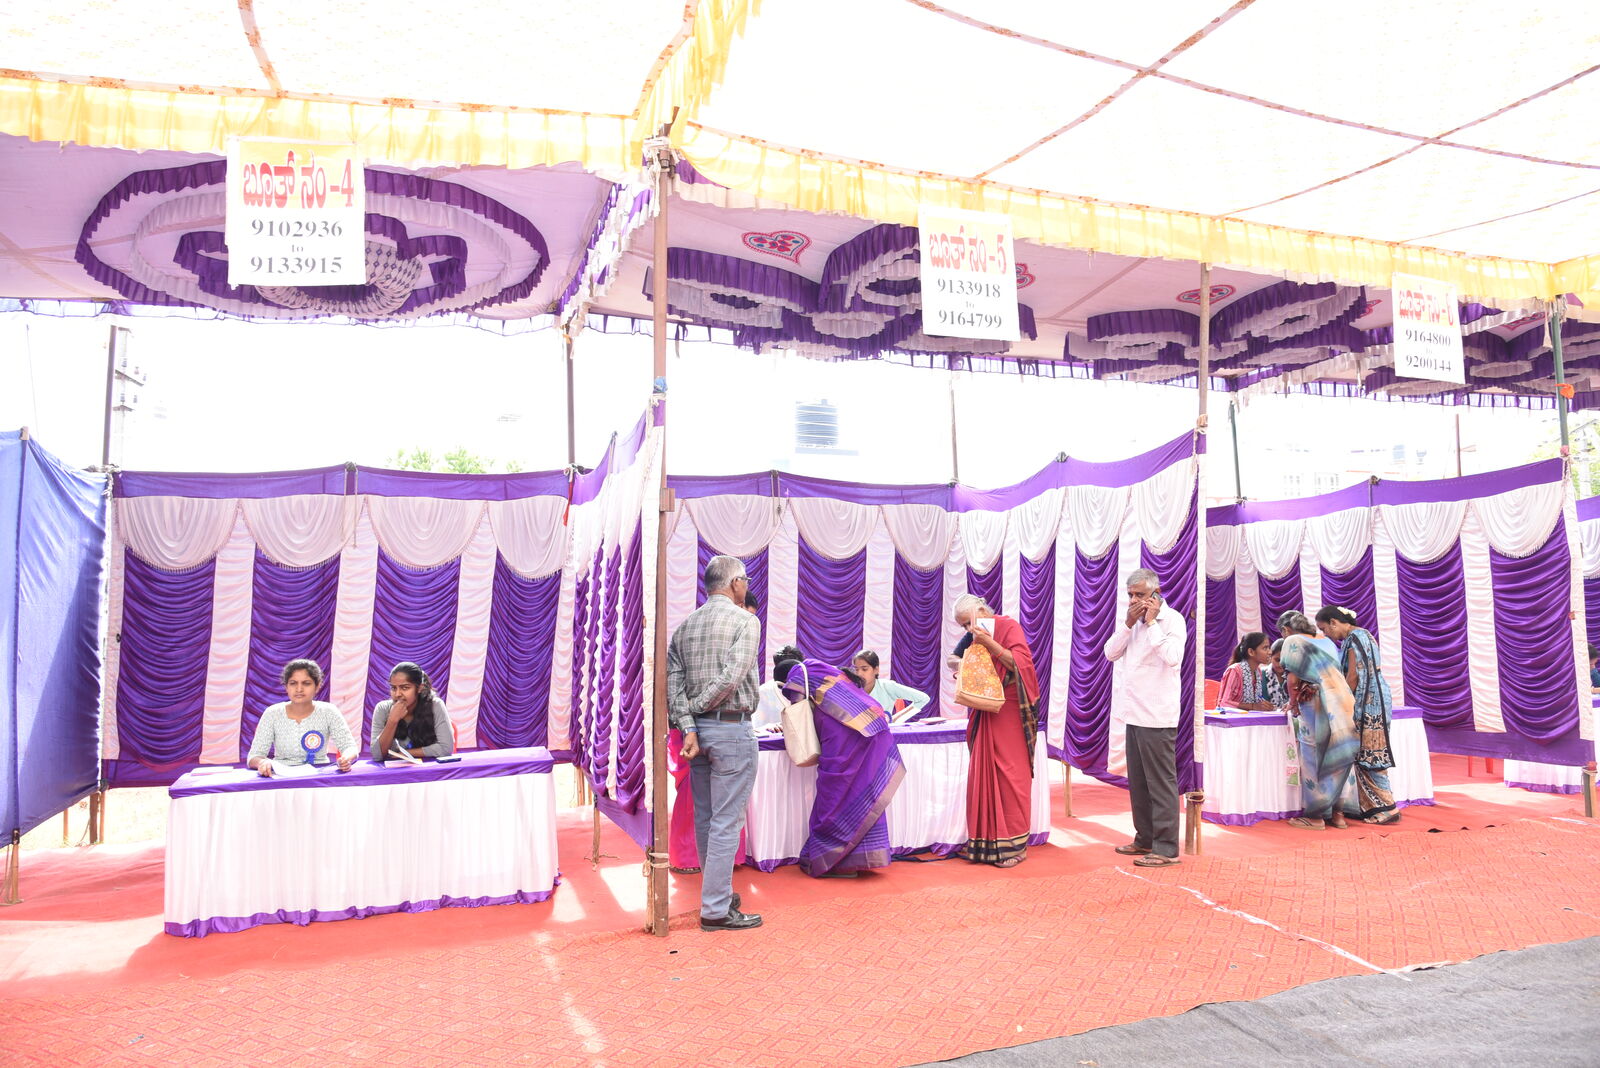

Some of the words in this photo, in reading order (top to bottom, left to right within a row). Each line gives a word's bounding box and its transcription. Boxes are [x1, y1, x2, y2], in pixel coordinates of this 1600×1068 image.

[243, 150, 295, 208] ಬೂತ್
[251, 219, 342, 237] 9102936
[291, 244, 304, 253] to
[929, 225, 965, 270] ಬೂತ್
[250, 256, 342, 274] 9133915
[937, 278, 1001, 298] 9133918
[938, 310, 1002, 328] 9164799
[1405, 329, 1451, 347] 9164800
[1405, 355, 1452, 373] 9200144
